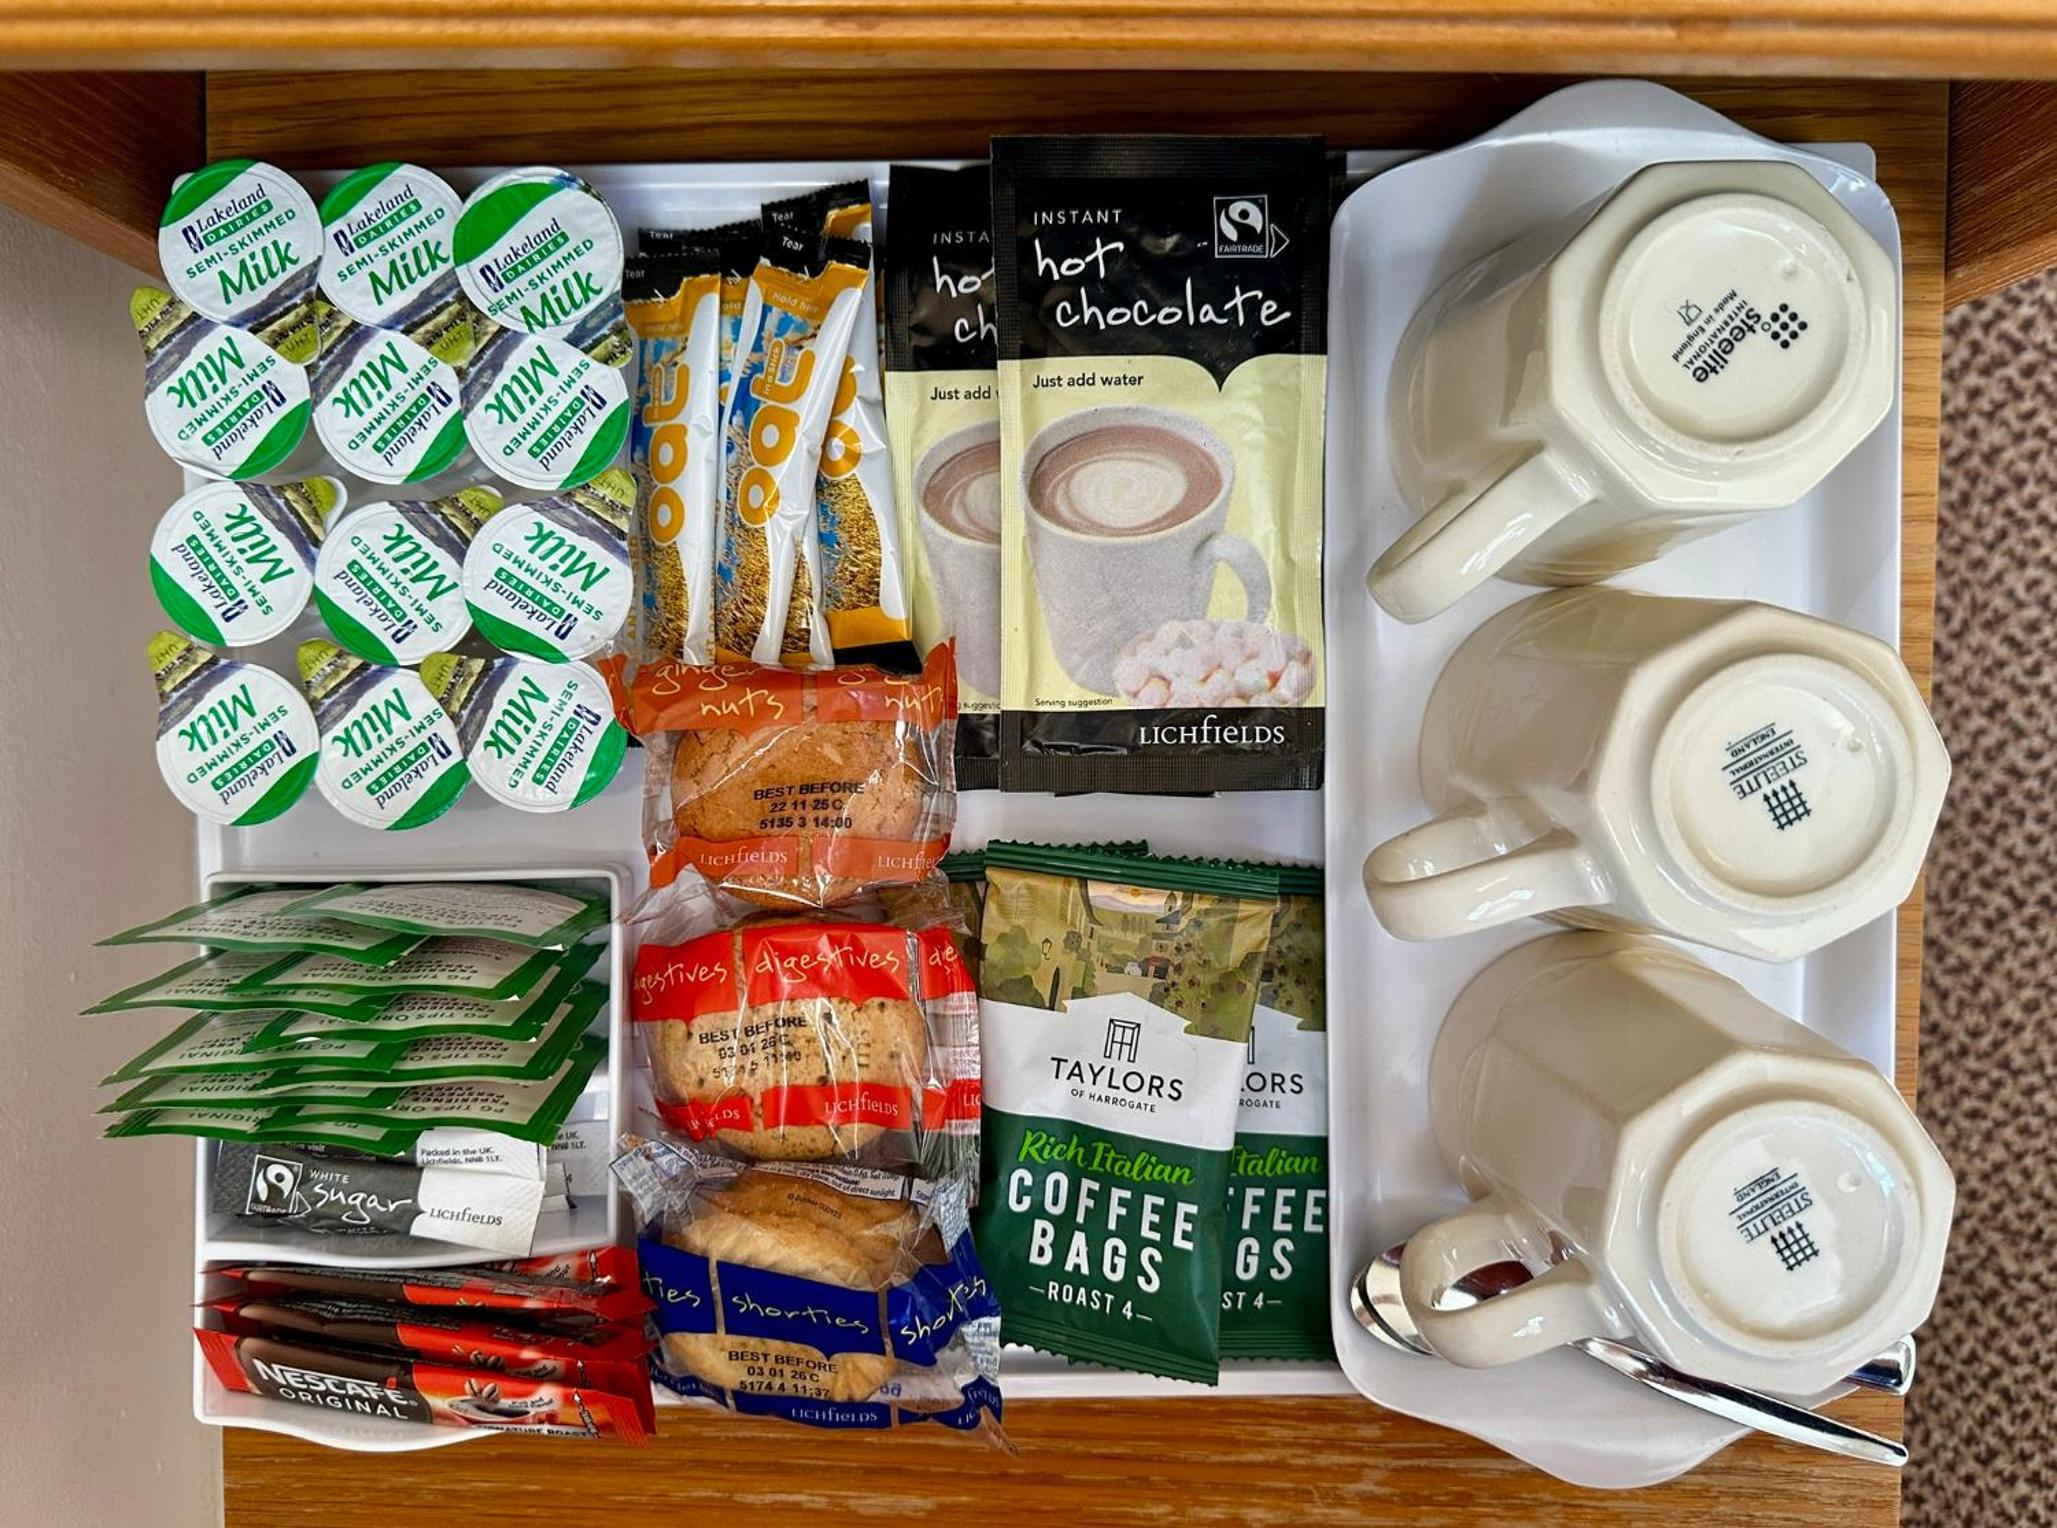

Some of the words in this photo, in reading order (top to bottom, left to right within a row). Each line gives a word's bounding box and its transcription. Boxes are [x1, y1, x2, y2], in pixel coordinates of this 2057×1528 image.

[197, 183, 267, 233] Lakeland
[205, 201, 272, 244] DAIRIES
[349, 184, 415, 236] Lakeland
[357, 202, 420, 246] DAIRIES
[772, 212, 794, 222] Tear
[1034, 210, 1123, 225] INSTANT
[186, 208, 297, 279] SEMI-SKIMMED
[337, 208, 445, 282] SEMI-SKIMMED
[494, 217, 561, 271] Lakeland
[506, 234, 568, 281] DAIRIES
[783, 236, 803, 251] Tear
[933, 231, 991, 244] INSTA
[1035, 238, 1124, 280] hot
[1218, 244, 1264, 254] FAIRTRADE
[218, 240, 299, 305] Milk
[368, 240, 449, 306] Milk
[488, 239, 593, 316] SEMI-SKIMMED
[625, 270, 645, 278] Tear
[520, 269, 603, 334] Milk
[1055, 277, 1291, 329] chocolate
[1704, 315, 1715, 325] in
[1714, 289, 1737, 314] Made
[441, 332, 464, 351] UHT
[1672, 325, 1705, 362] England
[1682, 300, 1748, 370] INTERNATIONAL
[1692, 308, 1761, 382] steelite
[167, 335, 246, 408] Milk
[332, 341, 408, 418] Milk
[485, 345, 559, 424] Milk
[930, 387, 960, 400] Just
[964, 386, 991, 399] add
[1033, 374, 1063, 389] Just
[1072, 373, 1096, 387] add
[1100, 374, 1143, 386] water
[177, 355, 276, 441] SEMI-SKIMMED
[205, 393, 263, 444] DAIRIES
[348, 357, 438, 451] SEMI-SKIMMED
[503, 359, 591, 456] SEMI-SKIMMED
[212, 401, 274, 460] Lakeland
[376, 396, 429, 451] DAIRIES
[384, 402, 441, 467] Lakeland
[531, 399, 584, 455] DAIRIES
[539, 409, 596, 471] Lakeland
[738, 338, 816, 526] oat
[186, 537, 238, 599] DAIRIES
[192, 510, 273, 615] SEMI-SKIMMED
[224, 503, 295, 584] Milk
[383, 523, 459, 602] Milk
[524, 521, 610, 593] Milk
[171, 543, 228, 609] Lakeland
[334, 570, 395, 631] Lakeland
[349, 562, 408, 620] DAIRIES
[351, 536, 442, 633] SEMI-SKIMMED
[492, 543, 604, 621] SEMI-SKIMMED
[497, 569, 562, 617] DAIRIES
[483, 578, 557, 631] Lakeland
[178, 683, 258, 752] Milk
[331, 687, 412, 758] Milk
[484, 676, 549, 759] Milk
[701, 688, 784, 720] nuts
[885, 686, 943, 712] nut
[1035, 698, 1065, 708] Serving
[1068, 698, 1112, 708] suggestion
[187, 705, 288, 784] SEMI-SKIMMED
[342, 708, 443, 789] SEMI-SKIMMED
[508, 680, 578, 789] SEMI-SKIMMED
[533, 720, 578, 782] DAIRIES
[545, 723, 593, 795] Lakeland
[1731, 728, 1776, 758] ENGLAND
[213, 742, 274, 788] DAIRIES
[219, 754, 285, 805] Lakeland
[369, 744, 429, 793] DAIRIES
[374, 754, 439, 810] Lakeland
[1733, 750, 1808, 800] STEELITE
[754, 786, 794, 800] BEST
[799, 782, 864, 794] BEFORE
[770, 802, 786, 812] 22
[792, 800, 806, 810] 11
[760, 817, 793, 829] 5135
[798, 817, 806, 828] 3
[813, 817, 852, 828] 14:00
[755, 948, 899, 983] digestives
[700, 1029, 738, 1044] BEST
[744, 1017, 807, 1037] BEFORE
[719, 1047, 735, 1059] 03
[740, 1043, 755, 1055] 01
[1051, 1057, 1183, 1102] TAYLORS
[1070, 1088, 1085, 1098] OF
[1089, 1093, 1157, 1113] HARROGATE
[1239, 1099, 1281, 1109] ROGATE
[421, 1149, 450, 1157] Packed
[567, 1131, 579, 1139] UK.
[1017, 1129, 1087, 1168] Rich
[1090, 1141, 1196, 1186] Italian
[310, 1170, 349, 1184] WHITE
[1736, 1172, 1781, 1202] ENGLAND
[314, 1183, 412, 1224] sugar
[1008, 1168, 1199, 1251] COFFEE
[1242, 1187, 1327, 1234] FEE
[1741, 1192, 1812, 1243] STEELITE
[1029, 1219, 1163, 1294] BAGS
[1236, 1237, 1295, 1281] GS
[642, 1276, 700, 1307] ties
[732, 1293, 869, 1333] shorties
[1048, 1282, 1114, 1314] ROAST
[1122, 1300, 1132, 1320] 4
[1253, 1292, 1263, 1308] 4
[729, 1350, 770, 1364] BEST
[774, 1354, 838, 1374] BEFORE
[739, 1380, 774, 1392] 5174
[778, 1381, 786, 1393] 4
[747, 1366, 765, 1377] 03
[769, 1367, 784, 1379] 01
[279, 1388, 408, 1419] ORIGINAL
